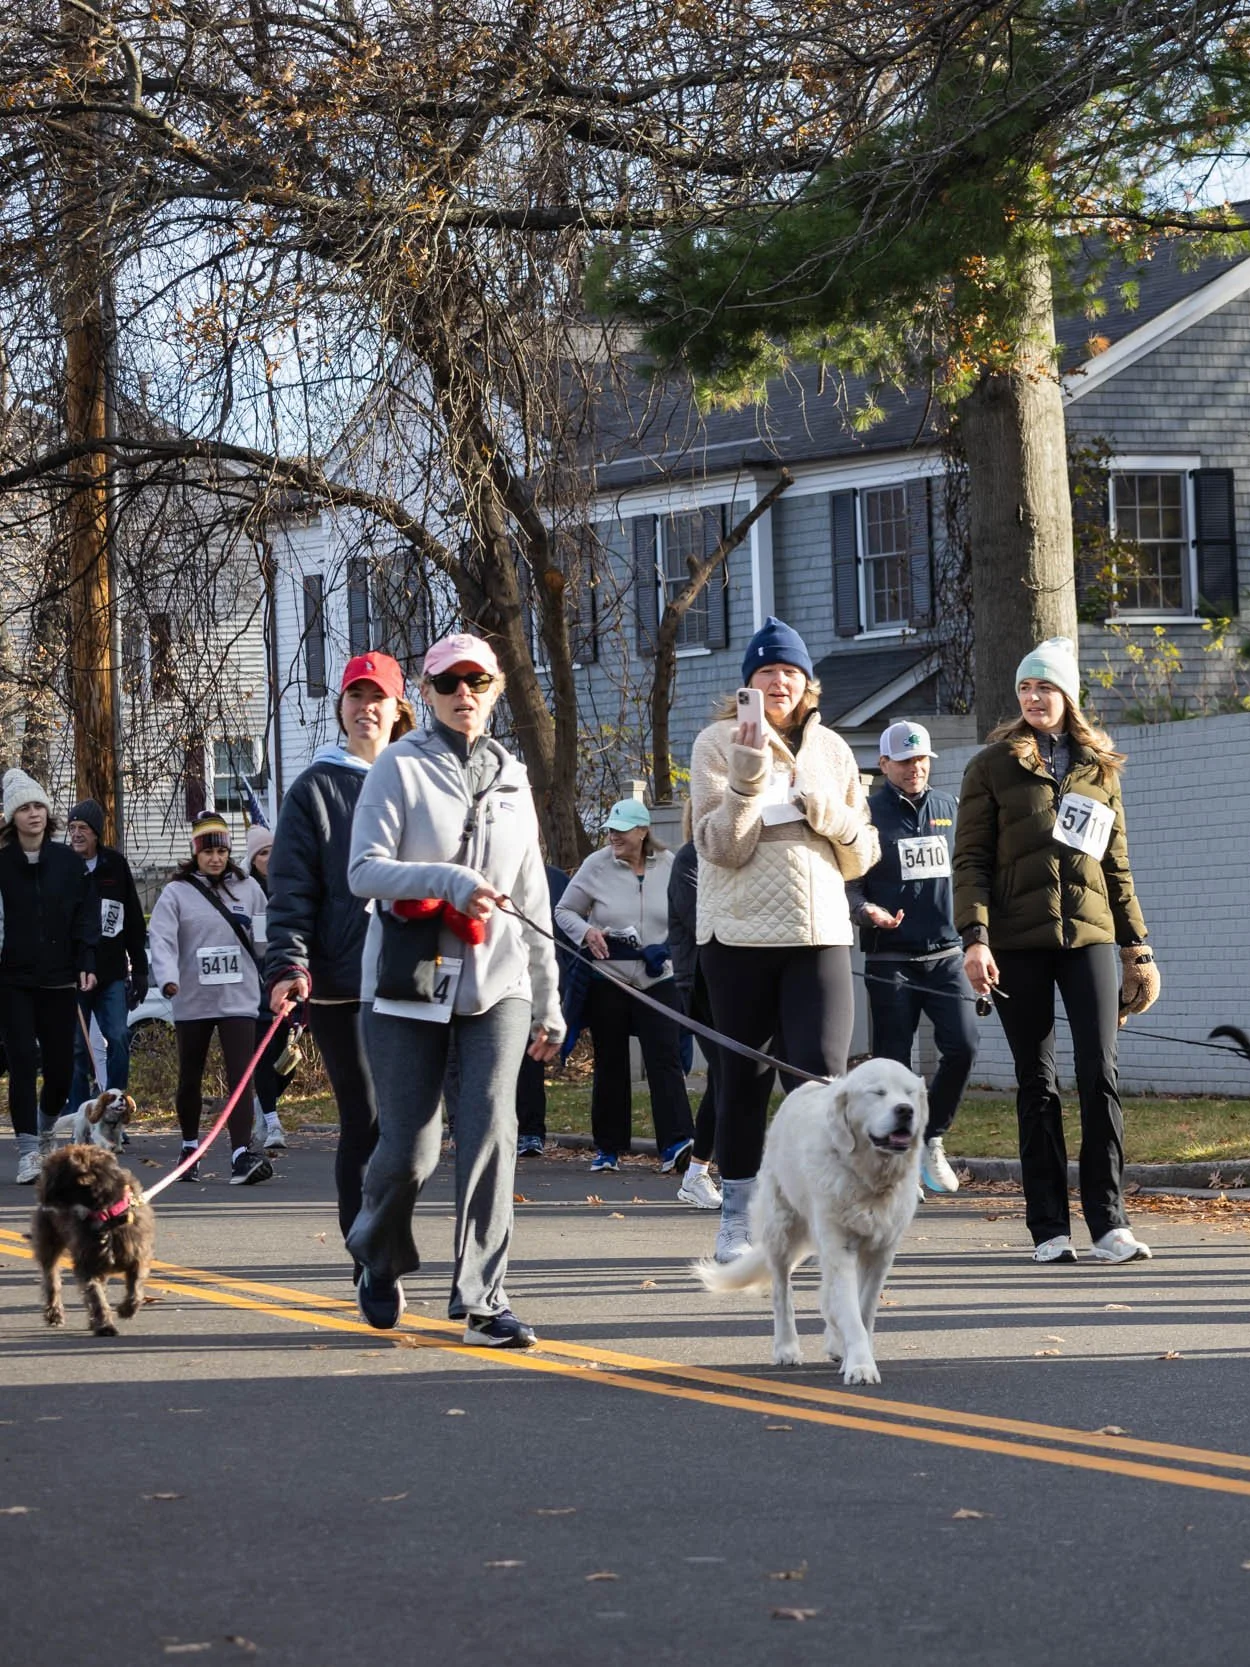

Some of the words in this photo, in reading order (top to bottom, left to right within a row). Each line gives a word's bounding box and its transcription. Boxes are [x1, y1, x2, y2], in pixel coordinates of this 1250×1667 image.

[1062, 806, 1106, 844] 5711
[905, 846, 945, 868] 5410
[103, 904, 121, 934] 5421
[202, 955, 239, 975] 5414
